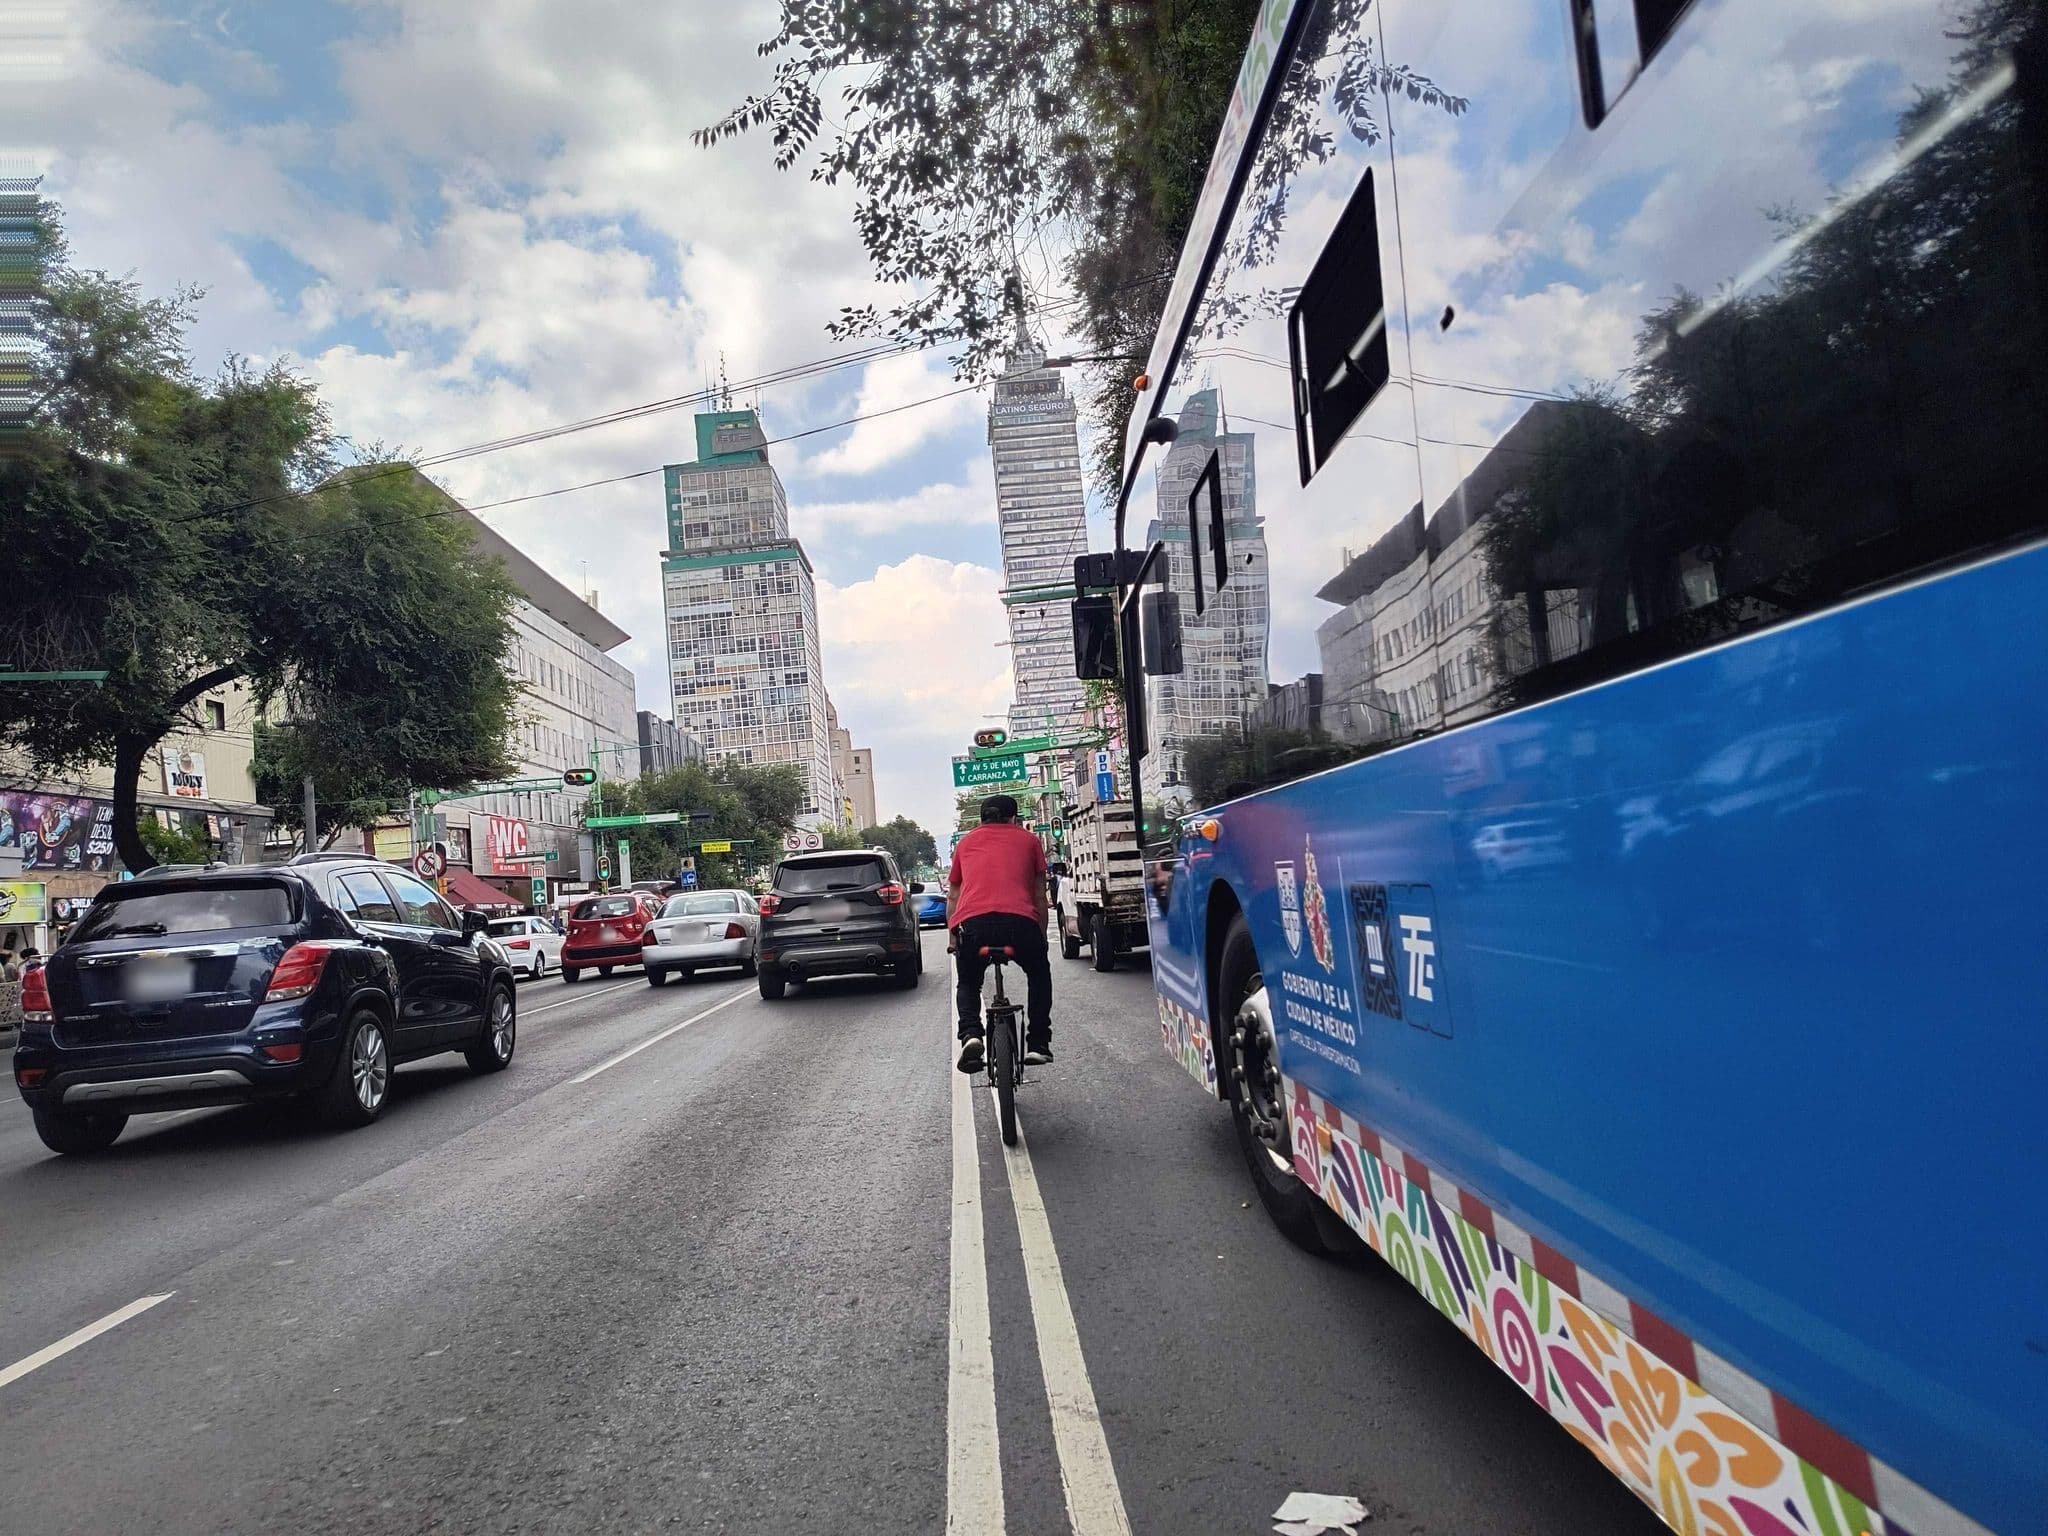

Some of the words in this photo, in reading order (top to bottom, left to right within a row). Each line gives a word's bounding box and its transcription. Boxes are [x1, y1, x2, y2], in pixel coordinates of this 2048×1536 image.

[996, 405, 1026, 415] LATINO
[1028, 401, 1070, 412] SEGUROS
[972, 764, 981, 772] AV
[1001, 759, 1020, 768] MAYO
[959, 775, 965, 783] V
[967, 771, 1008, 782] CARRANZA
[491, 819, 527, 857] WC
[86, 840, 113, 855] $250
[1282, 971, 1322, 1002] GOBIERNO
[1323, 983, 1336, 1008] DE
[1337, 987, 1352, 1013] LA
[1286, 999, 1312, 1027] CIUDAD
[1312, 1009, 1324, 1032] DE
[1323, 1011, 1356, 1047] MÉXICO
